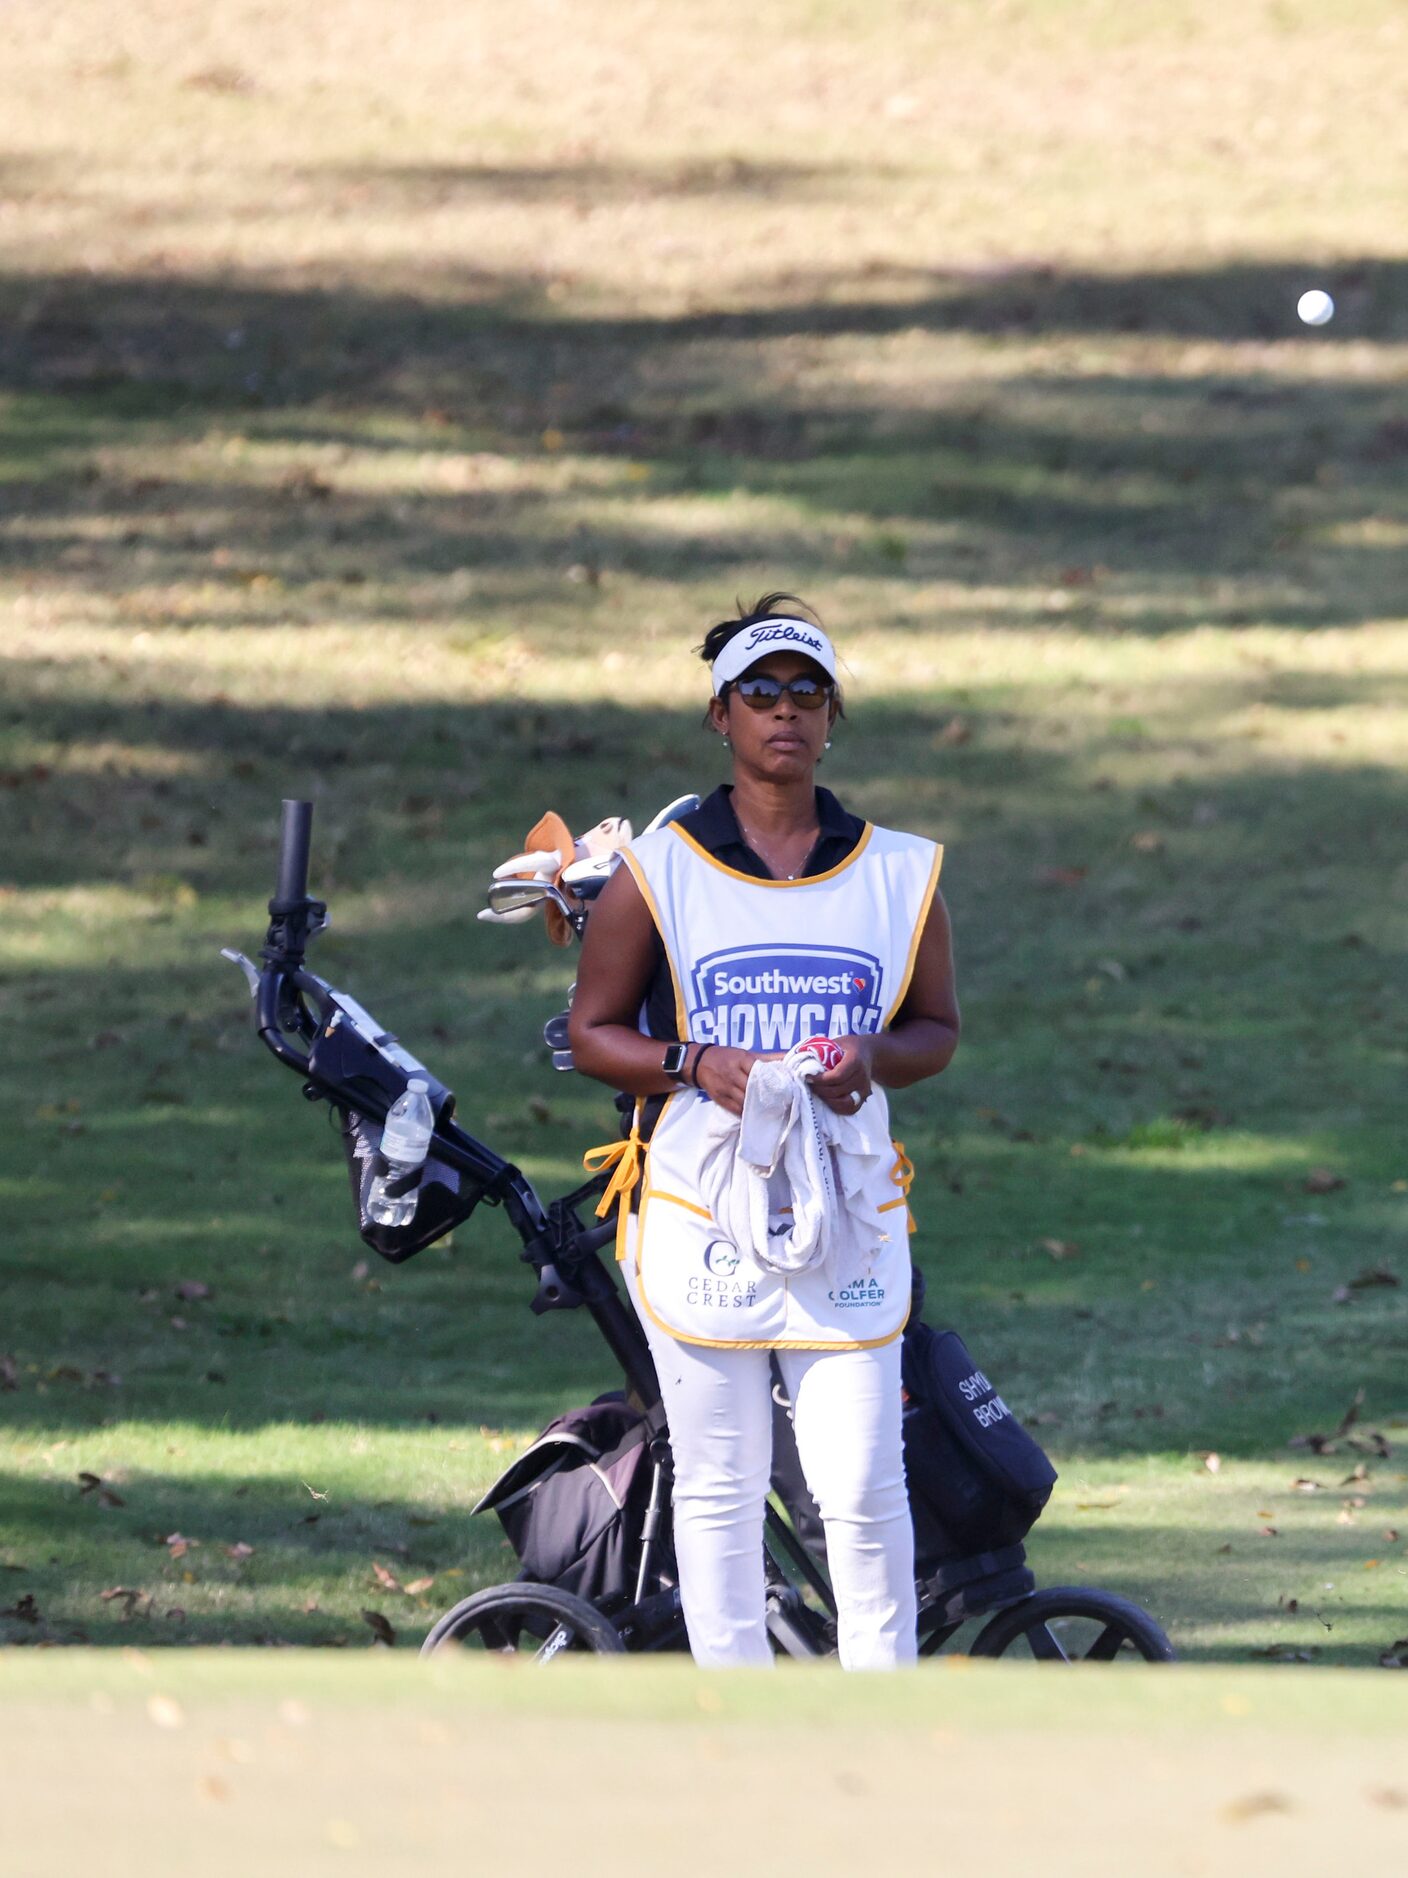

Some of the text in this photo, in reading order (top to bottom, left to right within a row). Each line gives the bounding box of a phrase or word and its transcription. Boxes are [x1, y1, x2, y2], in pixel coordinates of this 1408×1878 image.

[745, 624, 823, 651] Titleist
[714, 969, 852, 996] Southwest
[688, 1277, 756, 1293] CEDAR
[868, 1278, 878, 1288] A
[686, 1292, 756, 1308] CREST
[834, 1301, 881, 1309] FOUNDATION
[973, 1395, 1012, 1428] BROW
